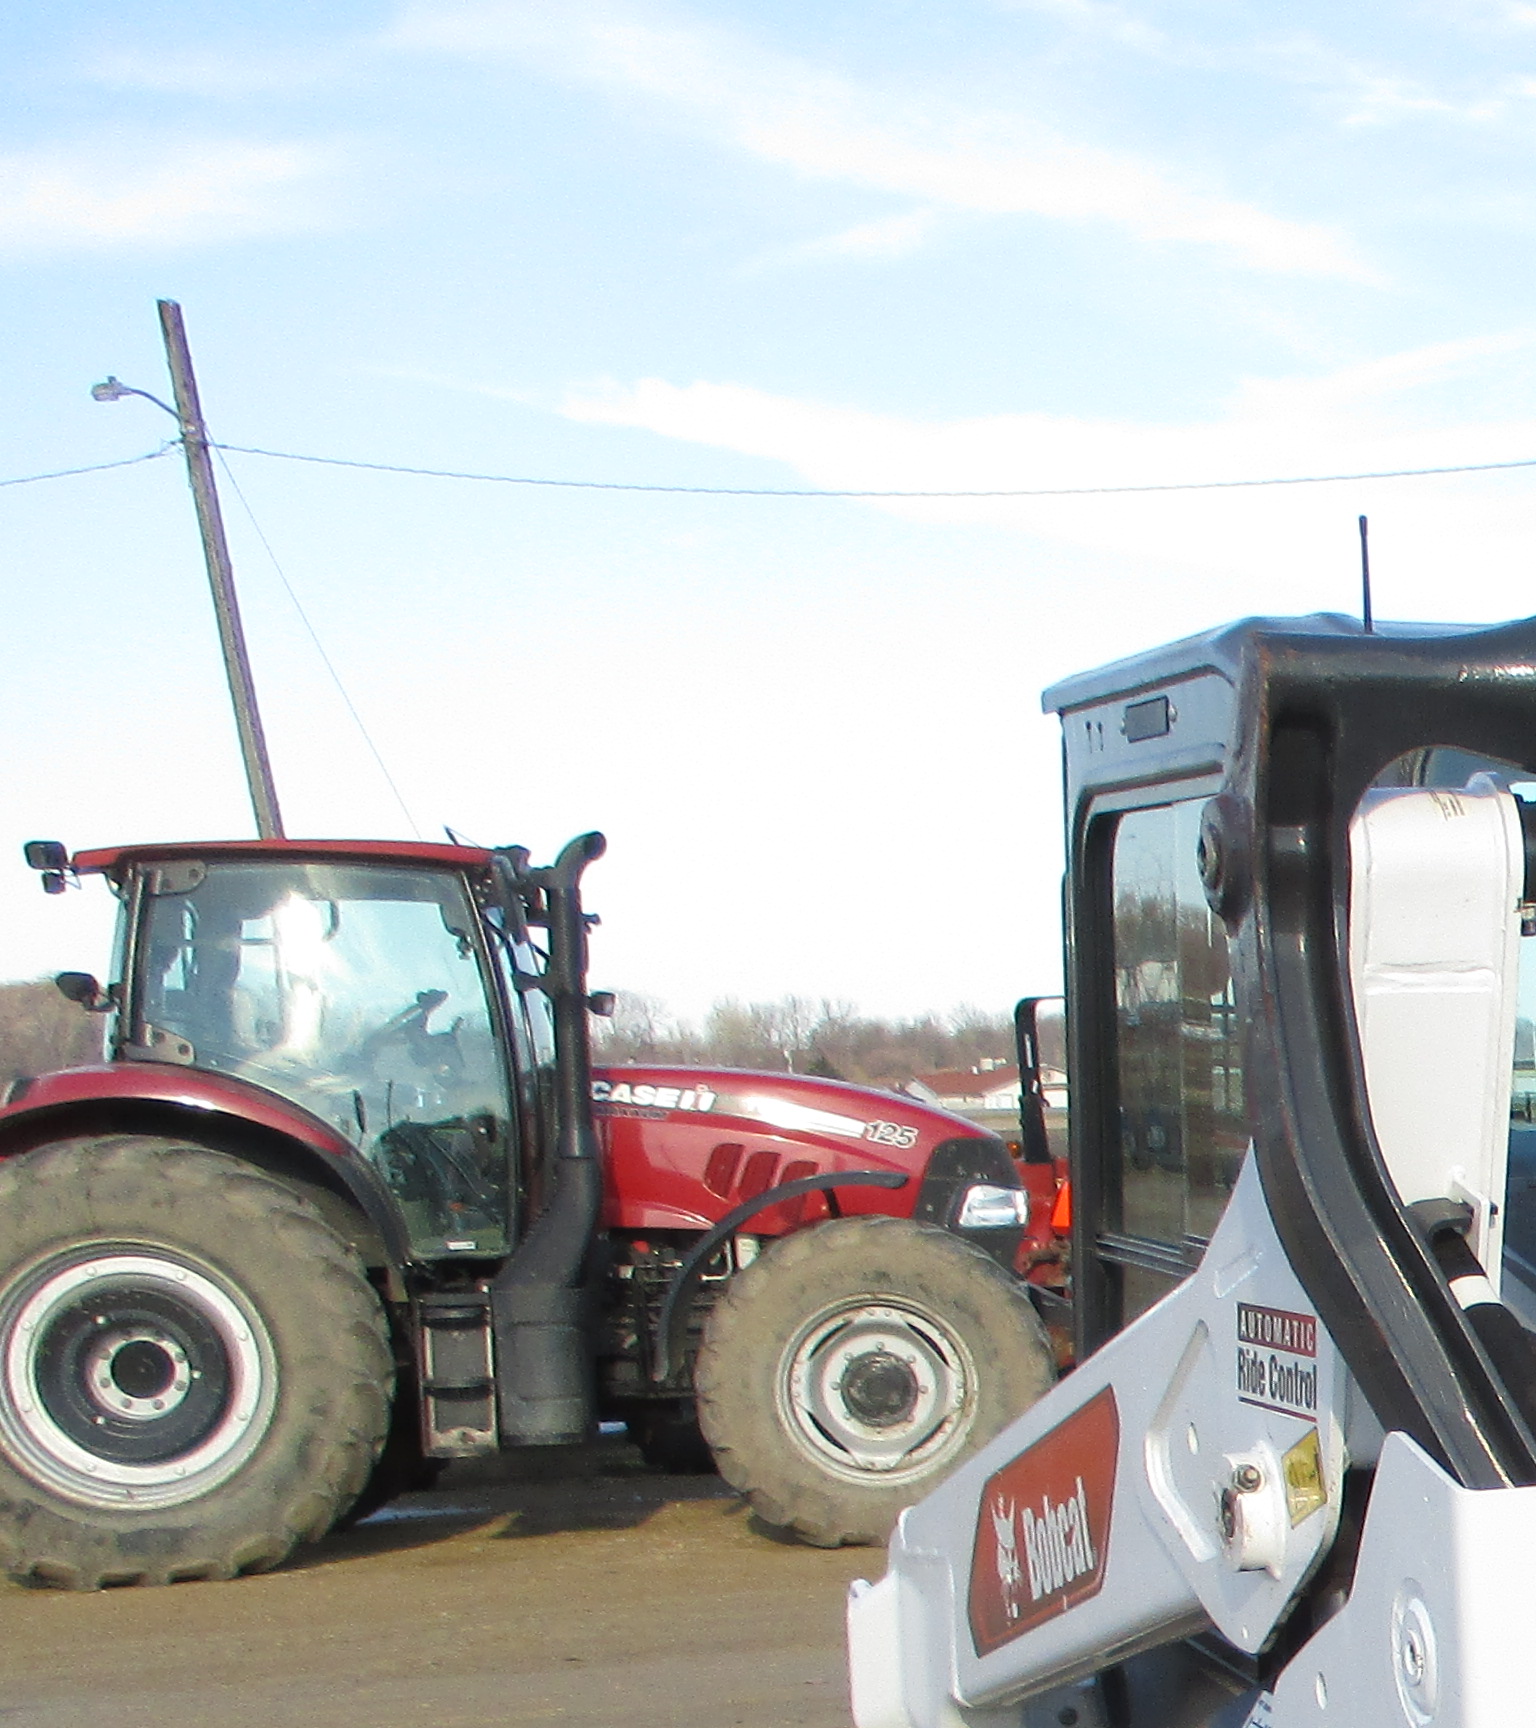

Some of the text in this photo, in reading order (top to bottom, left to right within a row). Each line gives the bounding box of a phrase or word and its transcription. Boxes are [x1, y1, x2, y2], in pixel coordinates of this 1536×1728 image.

[865, 1119, 919, 1148] 125
[1240, 1309, 1316, 1351] AUTOMATIC
[1237, 1346, 1318, 1411] Ride Control
[1022, 1476, 1094, 1601] Bobcat
